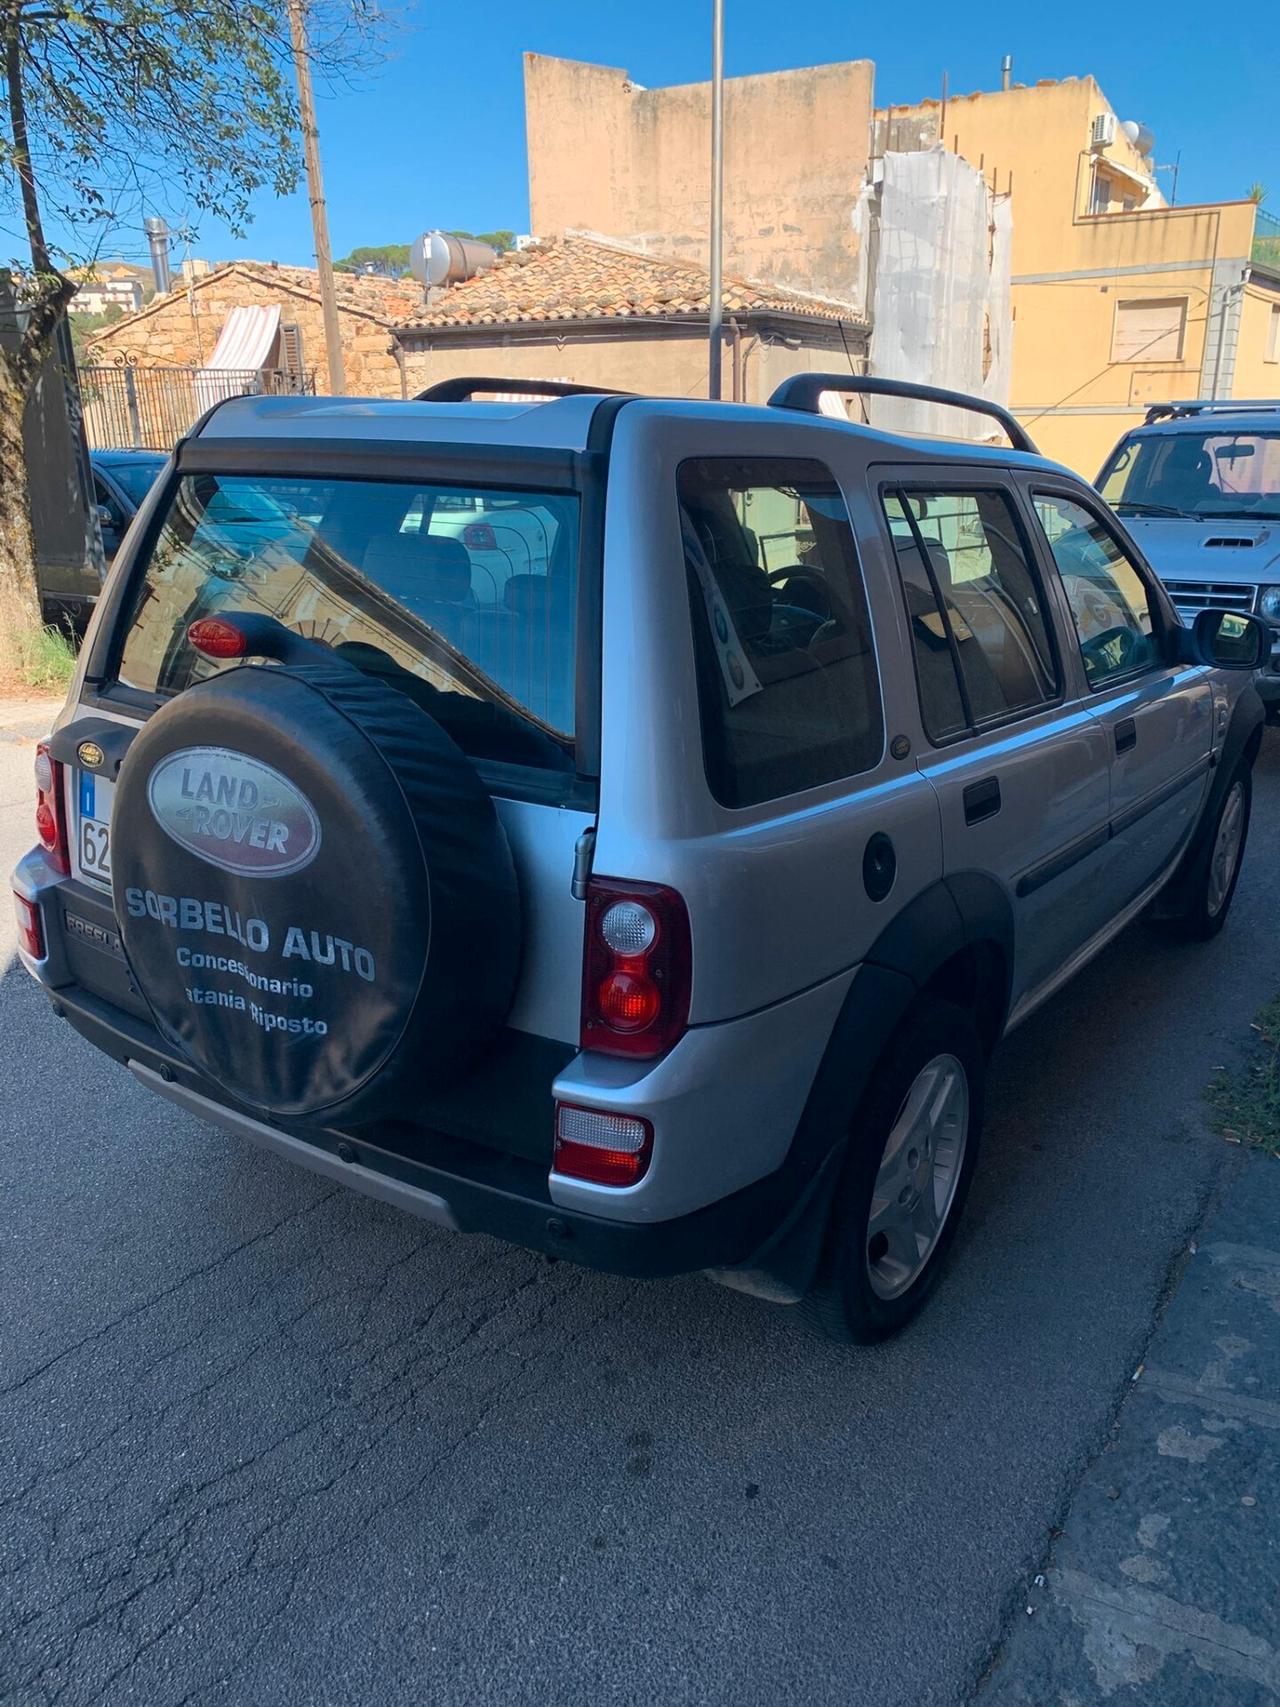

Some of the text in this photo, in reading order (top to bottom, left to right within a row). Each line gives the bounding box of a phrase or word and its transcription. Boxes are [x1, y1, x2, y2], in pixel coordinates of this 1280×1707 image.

[181, 768, 258, 811] LAND
[193, 805, 289, 854] ROVER
[125, 887, 376, 982] SORBELLO AUTO
[250, 1001, 328, 1035] Riposto
